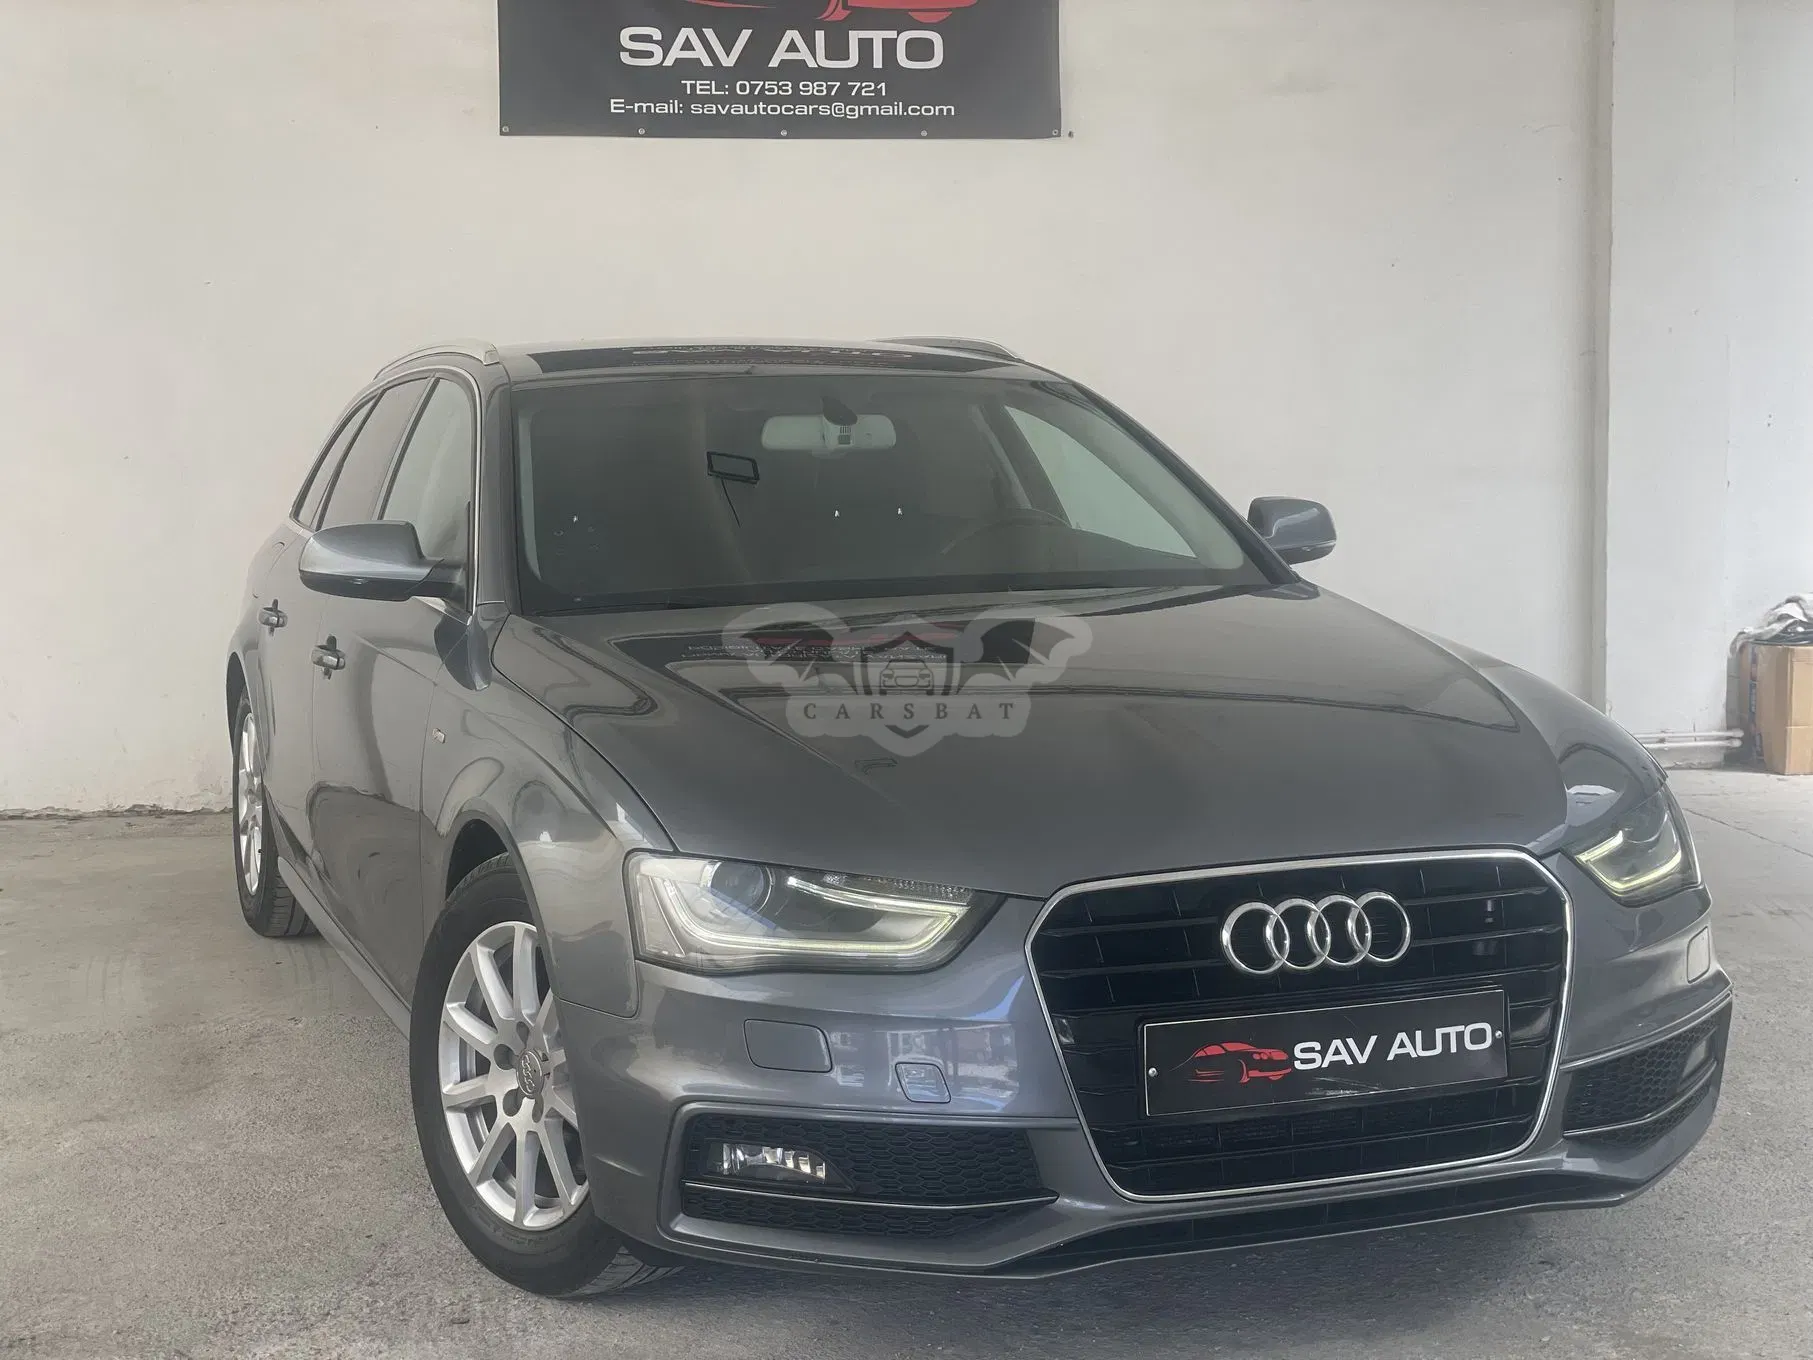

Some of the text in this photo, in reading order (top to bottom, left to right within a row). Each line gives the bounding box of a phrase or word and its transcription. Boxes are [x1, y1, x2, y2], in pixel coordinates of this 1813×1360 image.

[619, 26, 944, 69] SAV AUTO
[681, 80, 886, 97] TEL: 0753 987 721
[610, 98, 955, 118] E-mail: savautocars@gmail.com
[1293, 1022, 1493, 1070] SAV AUTO
